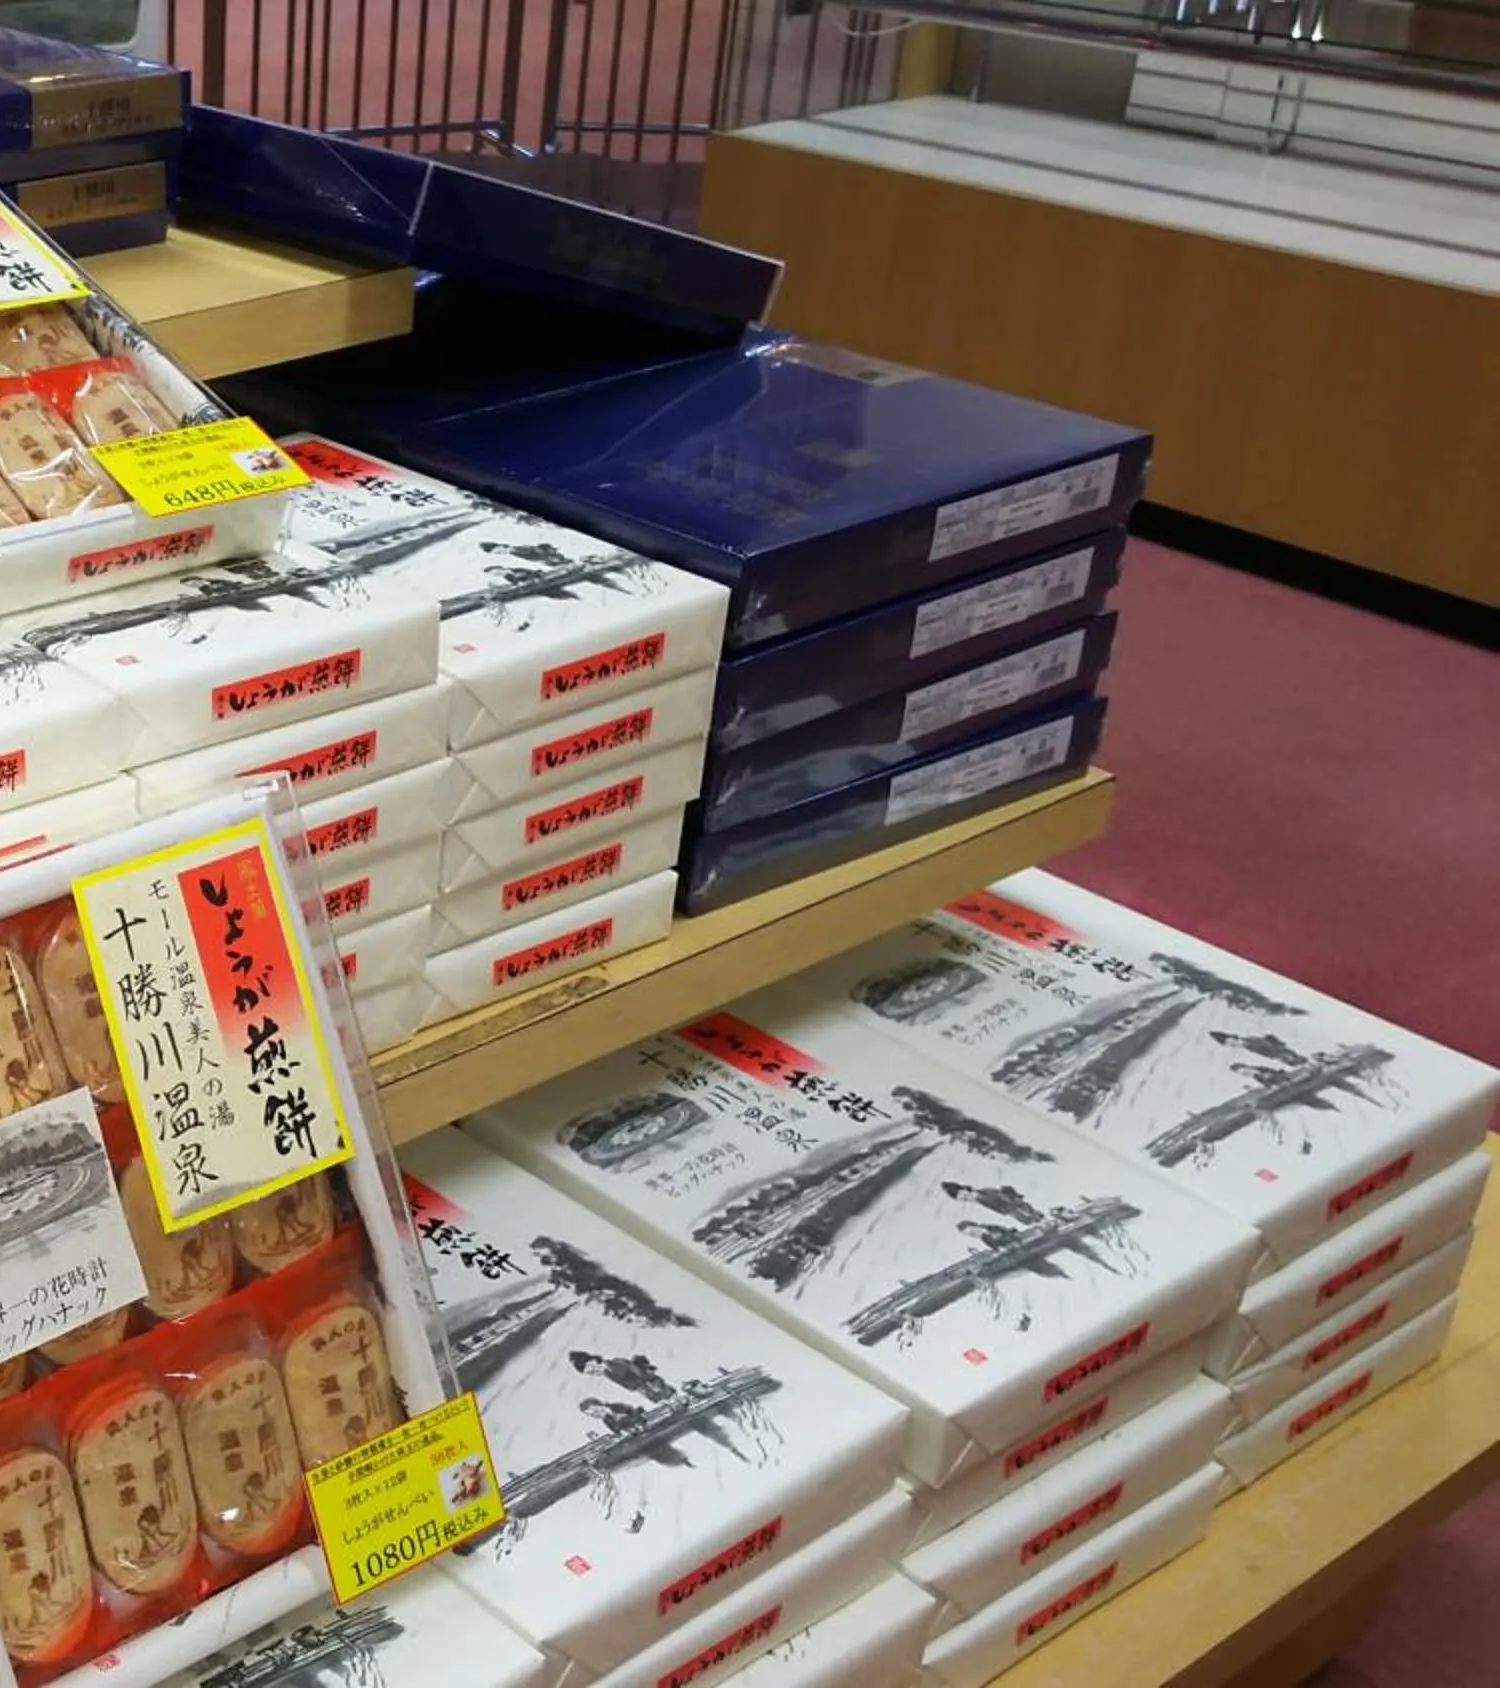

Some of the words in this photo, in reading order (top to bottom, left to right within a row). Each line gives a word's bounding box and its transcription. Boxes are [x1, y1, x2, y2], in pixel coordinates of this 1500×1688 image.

[103, 908, 219, 1196] 十勝川温泉
[148, 879, 235, 1130] モール温泉美人の湯
[200, 877, 317, 1158] しょうが煎餅
[343, 1489, 435, 1544] しょうがせんべい
[350, 1506, 489, 1587] 1080円税込み
